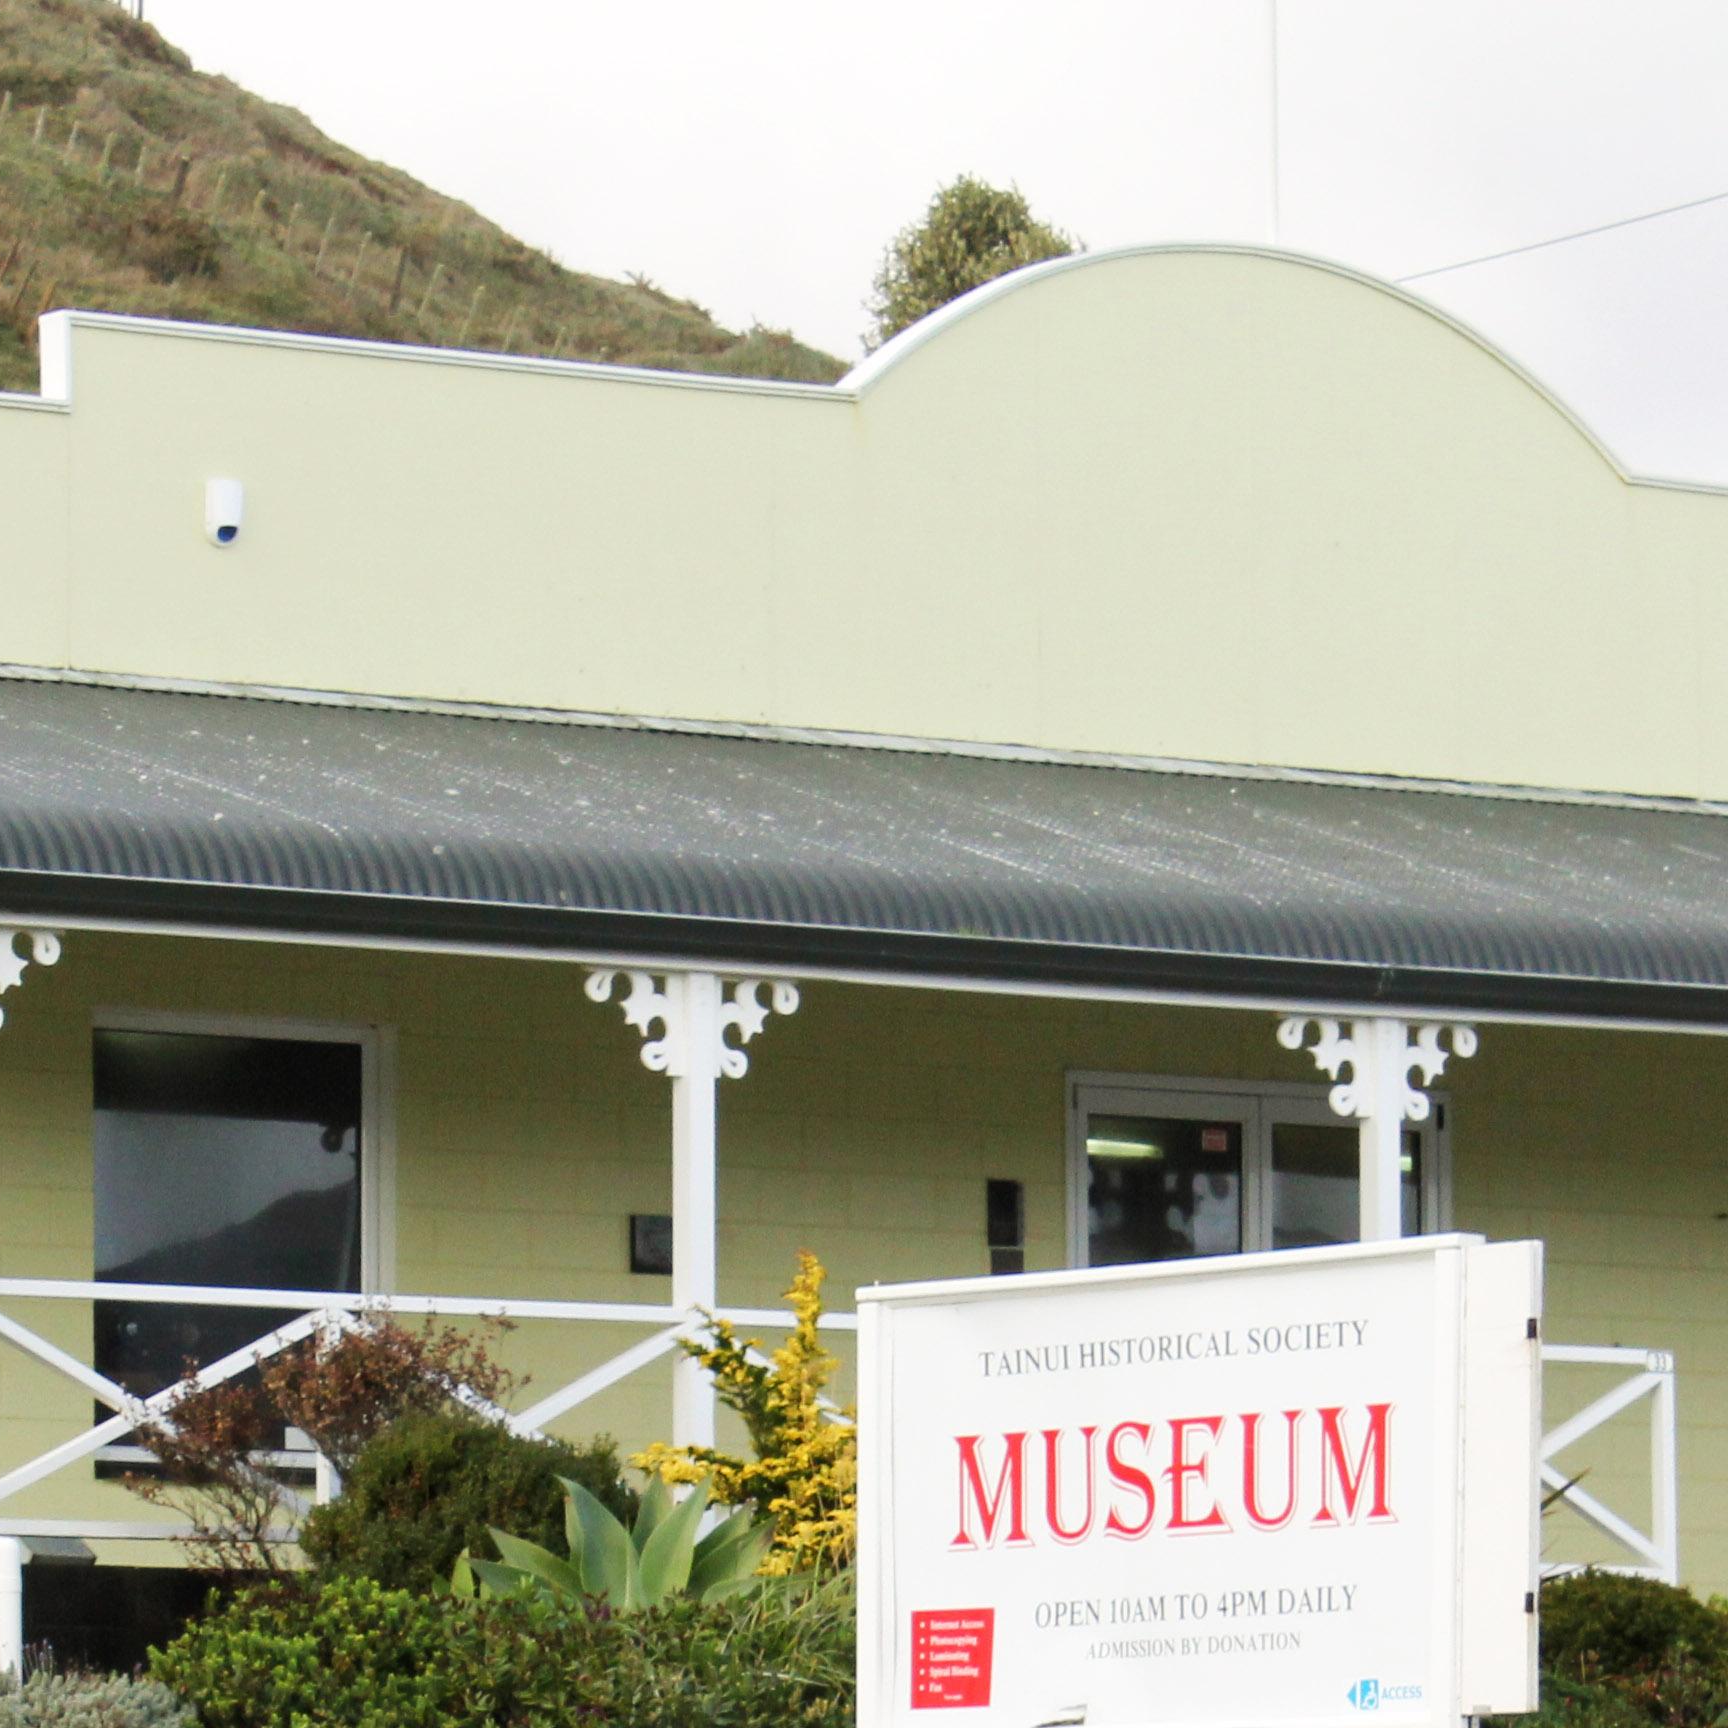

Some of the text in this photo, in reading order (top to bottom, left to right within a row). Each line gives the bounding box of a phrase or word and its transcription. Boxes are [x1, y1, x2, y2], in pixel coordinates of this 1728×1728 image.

[979, 1320, 1369, 1377] TAINUI HISTORICAL SOCIETY
[948, 1402, 1399, 1552] MUSEUM
[1035, 1585, 1358, 1628] OPEN 10AM TO 4PM DAILY
[1086, 1632, 1301, 1659] ADMISSION BY DONATION
[1381, 1686, 1422, 1699] ACCESS
